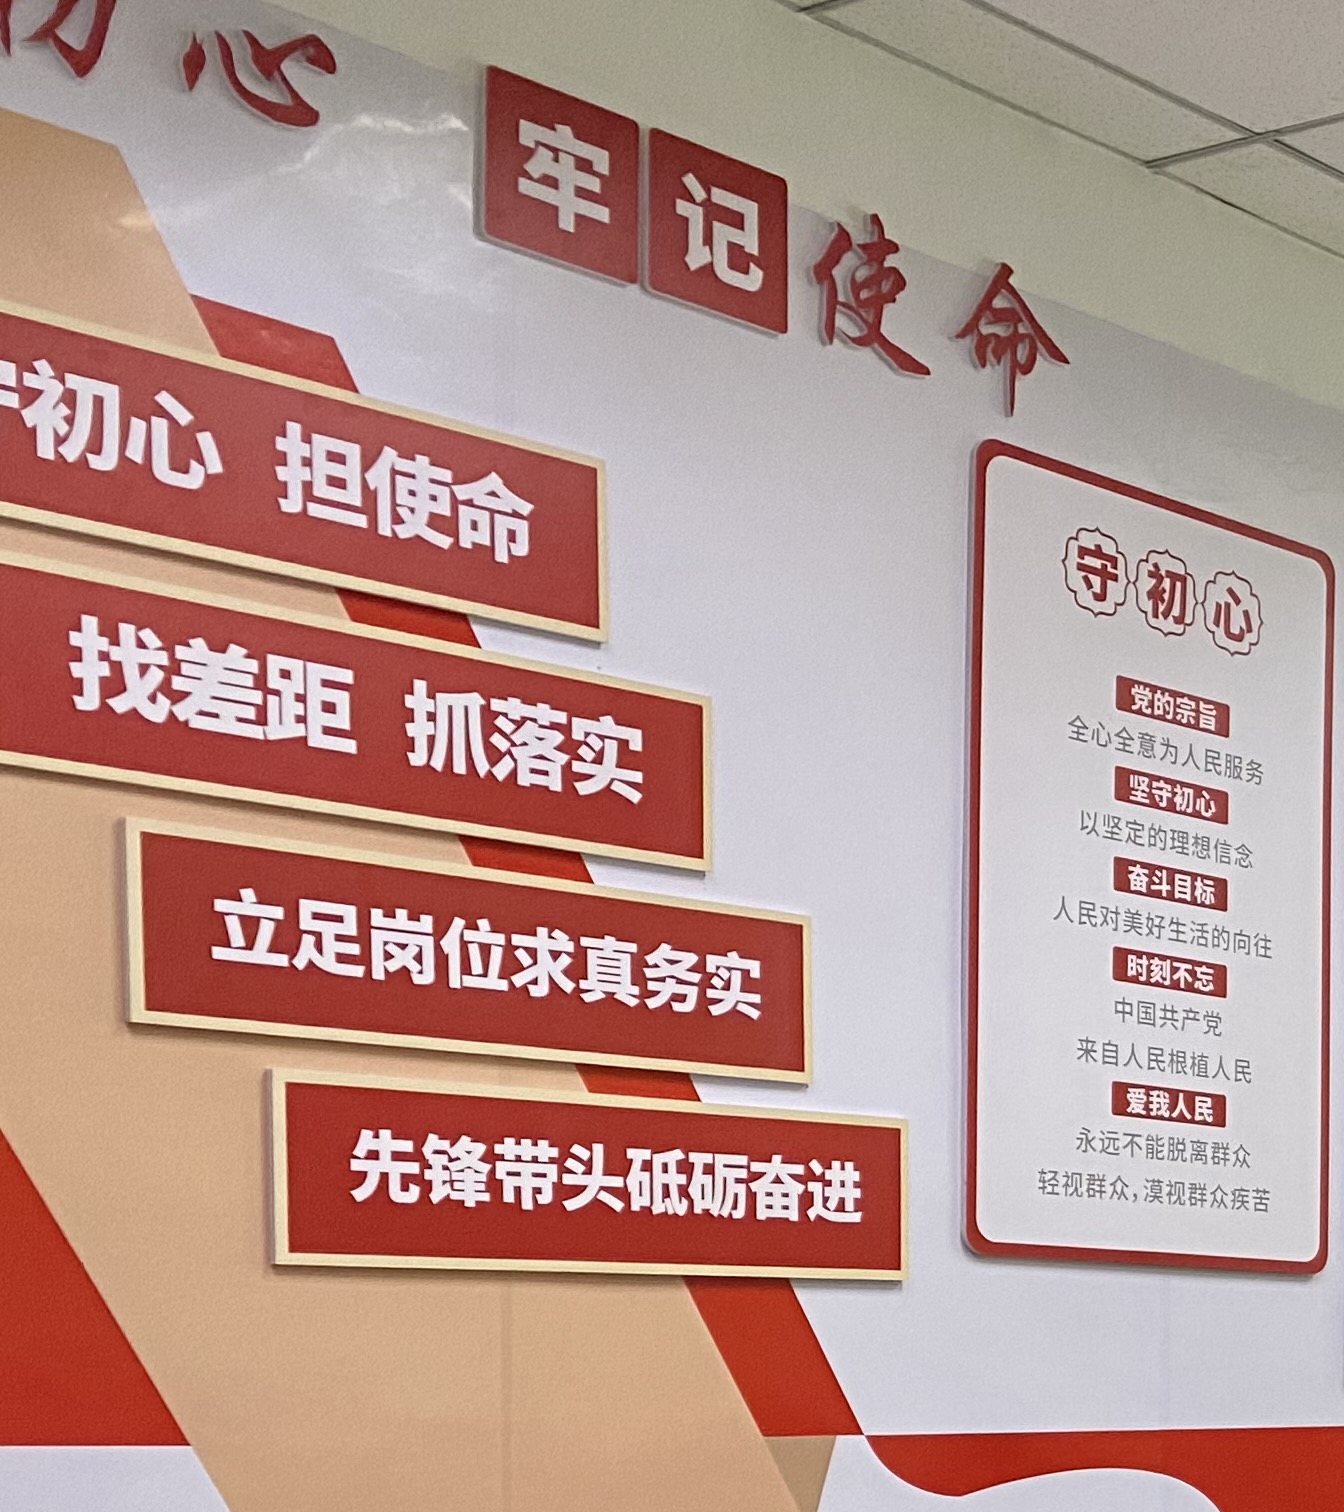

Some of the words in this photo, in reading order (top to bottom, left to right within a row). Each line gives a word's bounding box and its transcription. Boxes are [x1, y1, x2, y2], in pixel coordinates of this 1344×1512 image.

[275, 421, 534, 565] 担使命
[1076, 544, 1253, 642] 守初心
[69, 613, 357, 756] 找差距
[404, 680, 643, 803] 抓落实
[1131, 684, 1217, 732] 党的宗旨
[1068, 715, 1263, 786] 全心全意为人民服务
[1129, 774, 1216, 818] 坚守初心
[1080, 810, 1253, 869] 以坚定的理想信念
[1128, 864, 1215, 905] 奋斗目标
[211, 888, 762, 1020] 立足岗位求真务实
[1053, 895, 1273, 960] 人民对美好生活的向往
[1127, 954, 1214, 992] 时刻不忘
[1114, 999, 1222, 1037] 中国共产党
[1077, 1036, 1252, 1085] 来自人民根植人民
[1126, 1087, 1213, 1123] 爱我人民
[1076, 1126, 1251, 1169] 永远不能脱离群众
[349, 1129, 861, 1225] 先锋带头砥砺奋进
